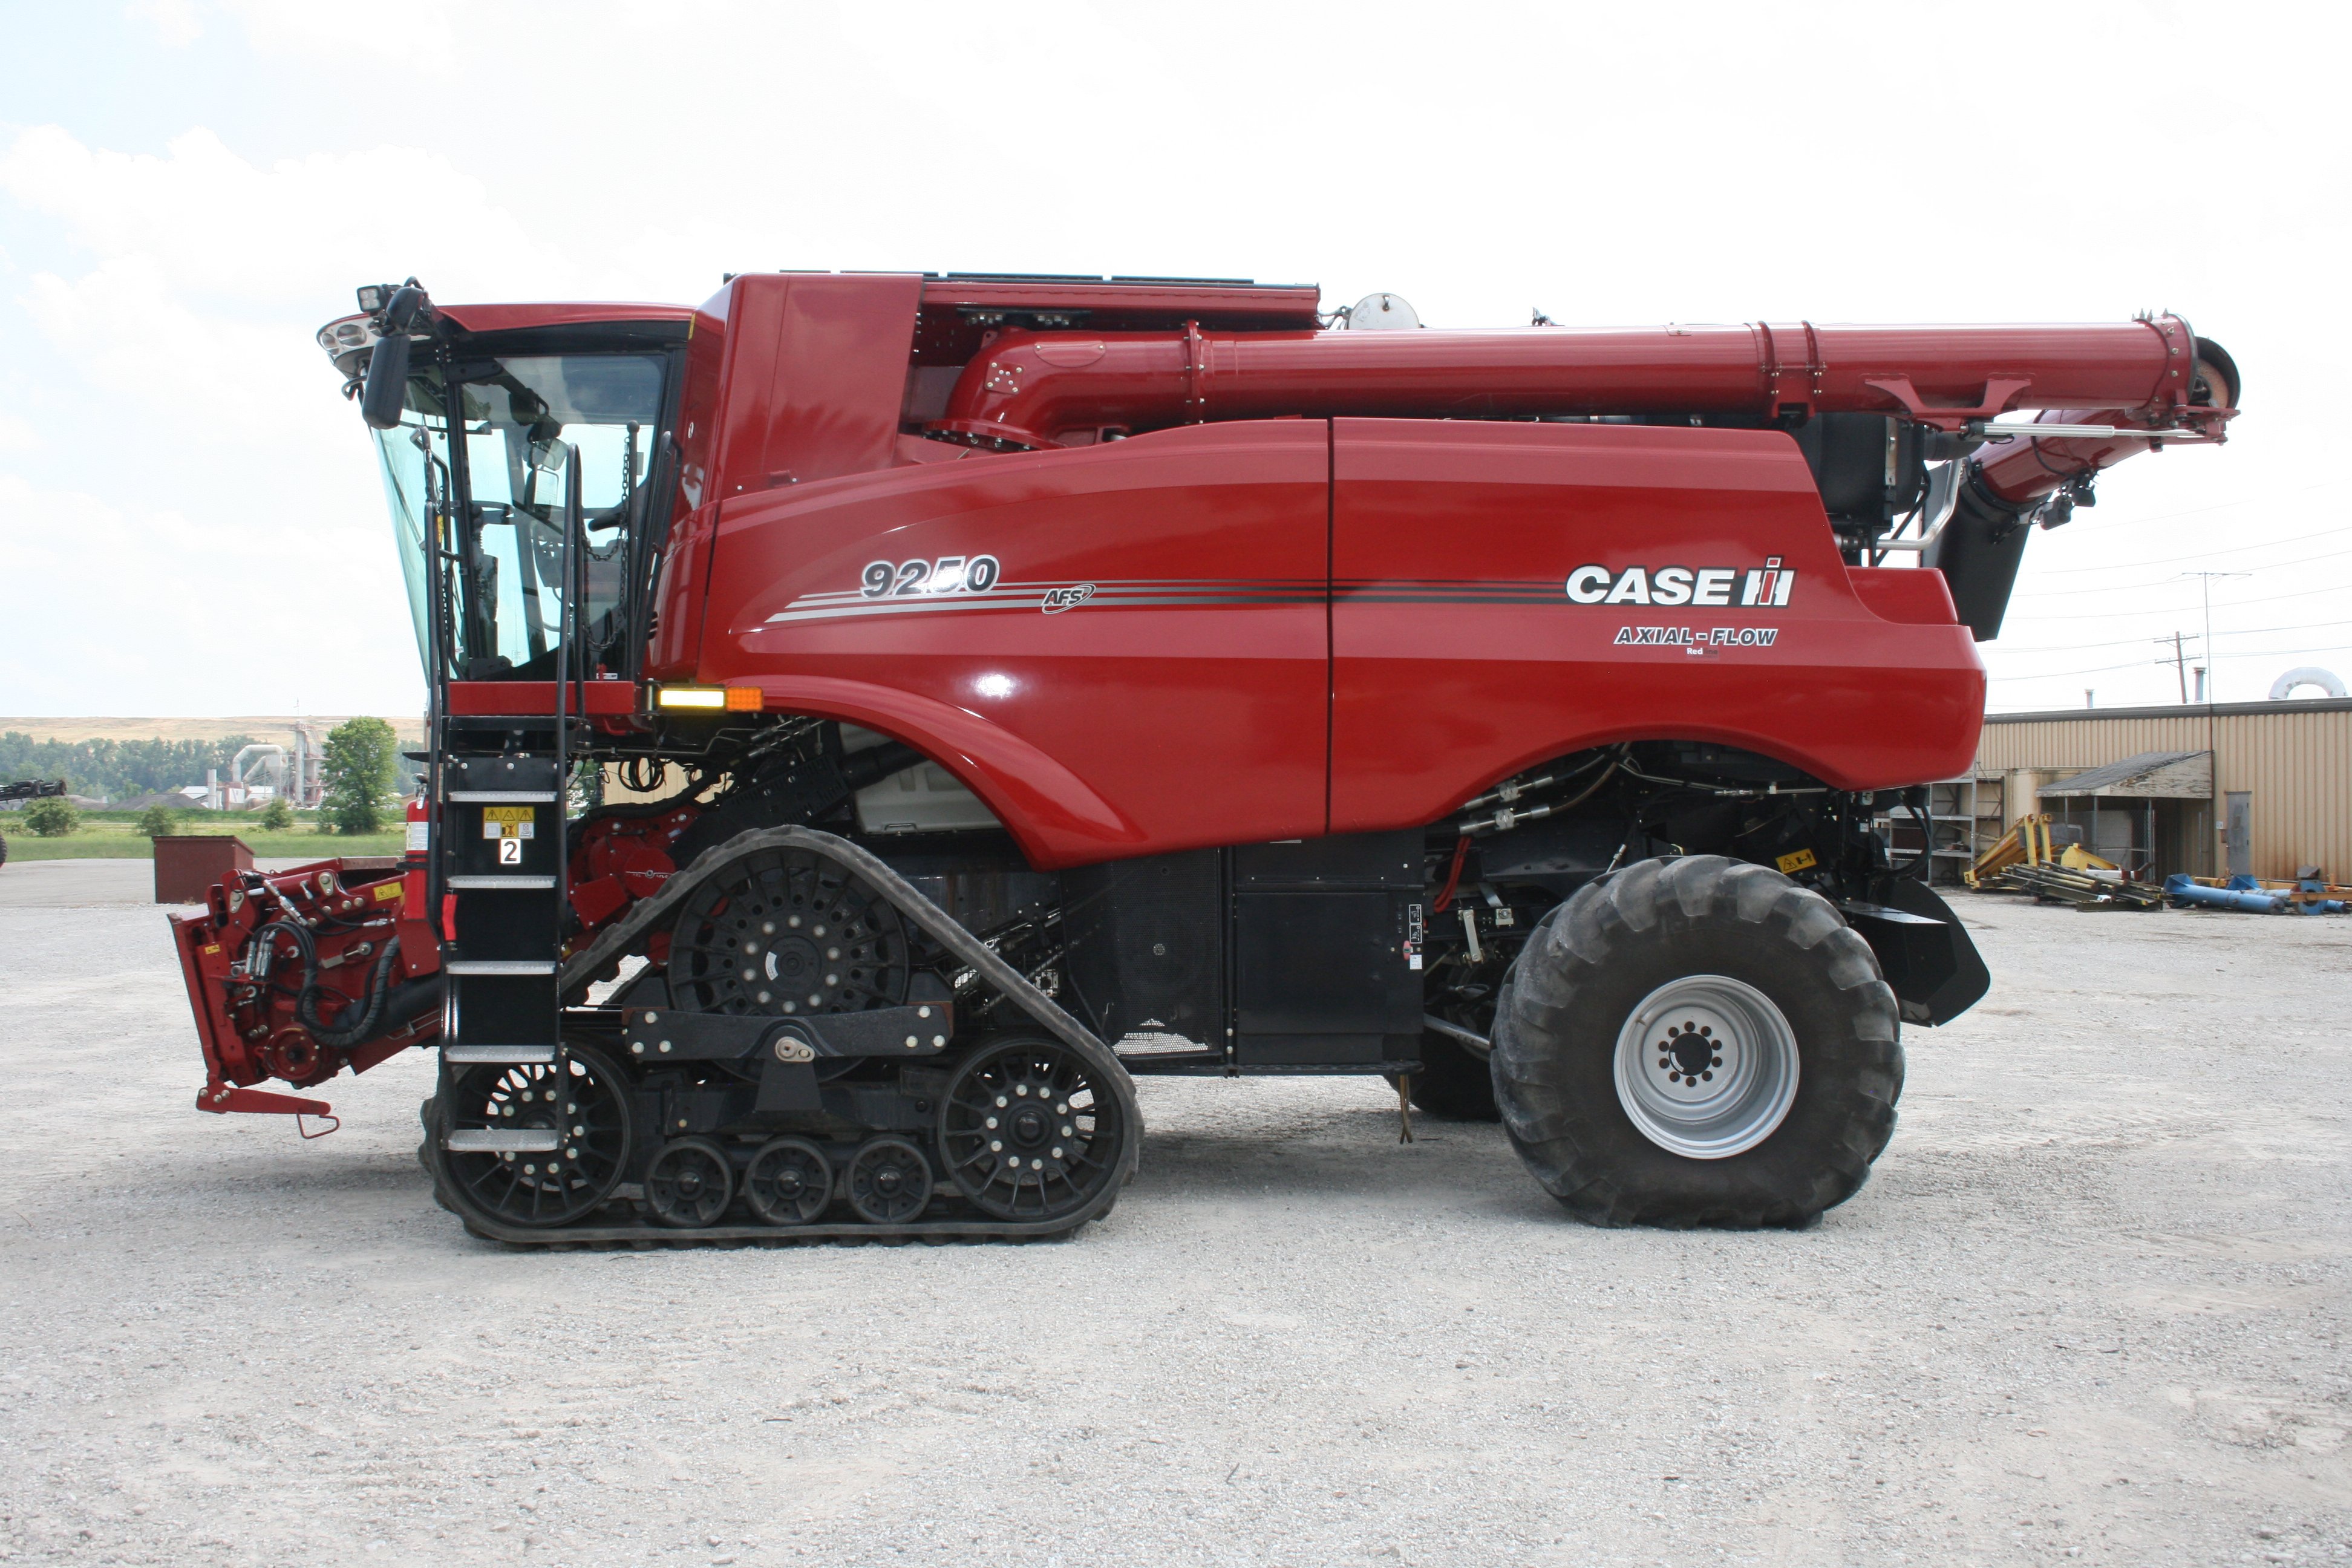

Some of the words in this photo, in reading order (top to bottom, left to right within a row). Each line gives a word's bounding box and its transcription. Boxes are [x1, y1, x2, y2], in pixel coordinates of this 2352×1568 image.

[860, 554, 1000, 599] 9250
[1566, 565, 1736, 606] CASE
[1041, 587, 1084, 606] AFS
[504, 841, 517, 861] 2
